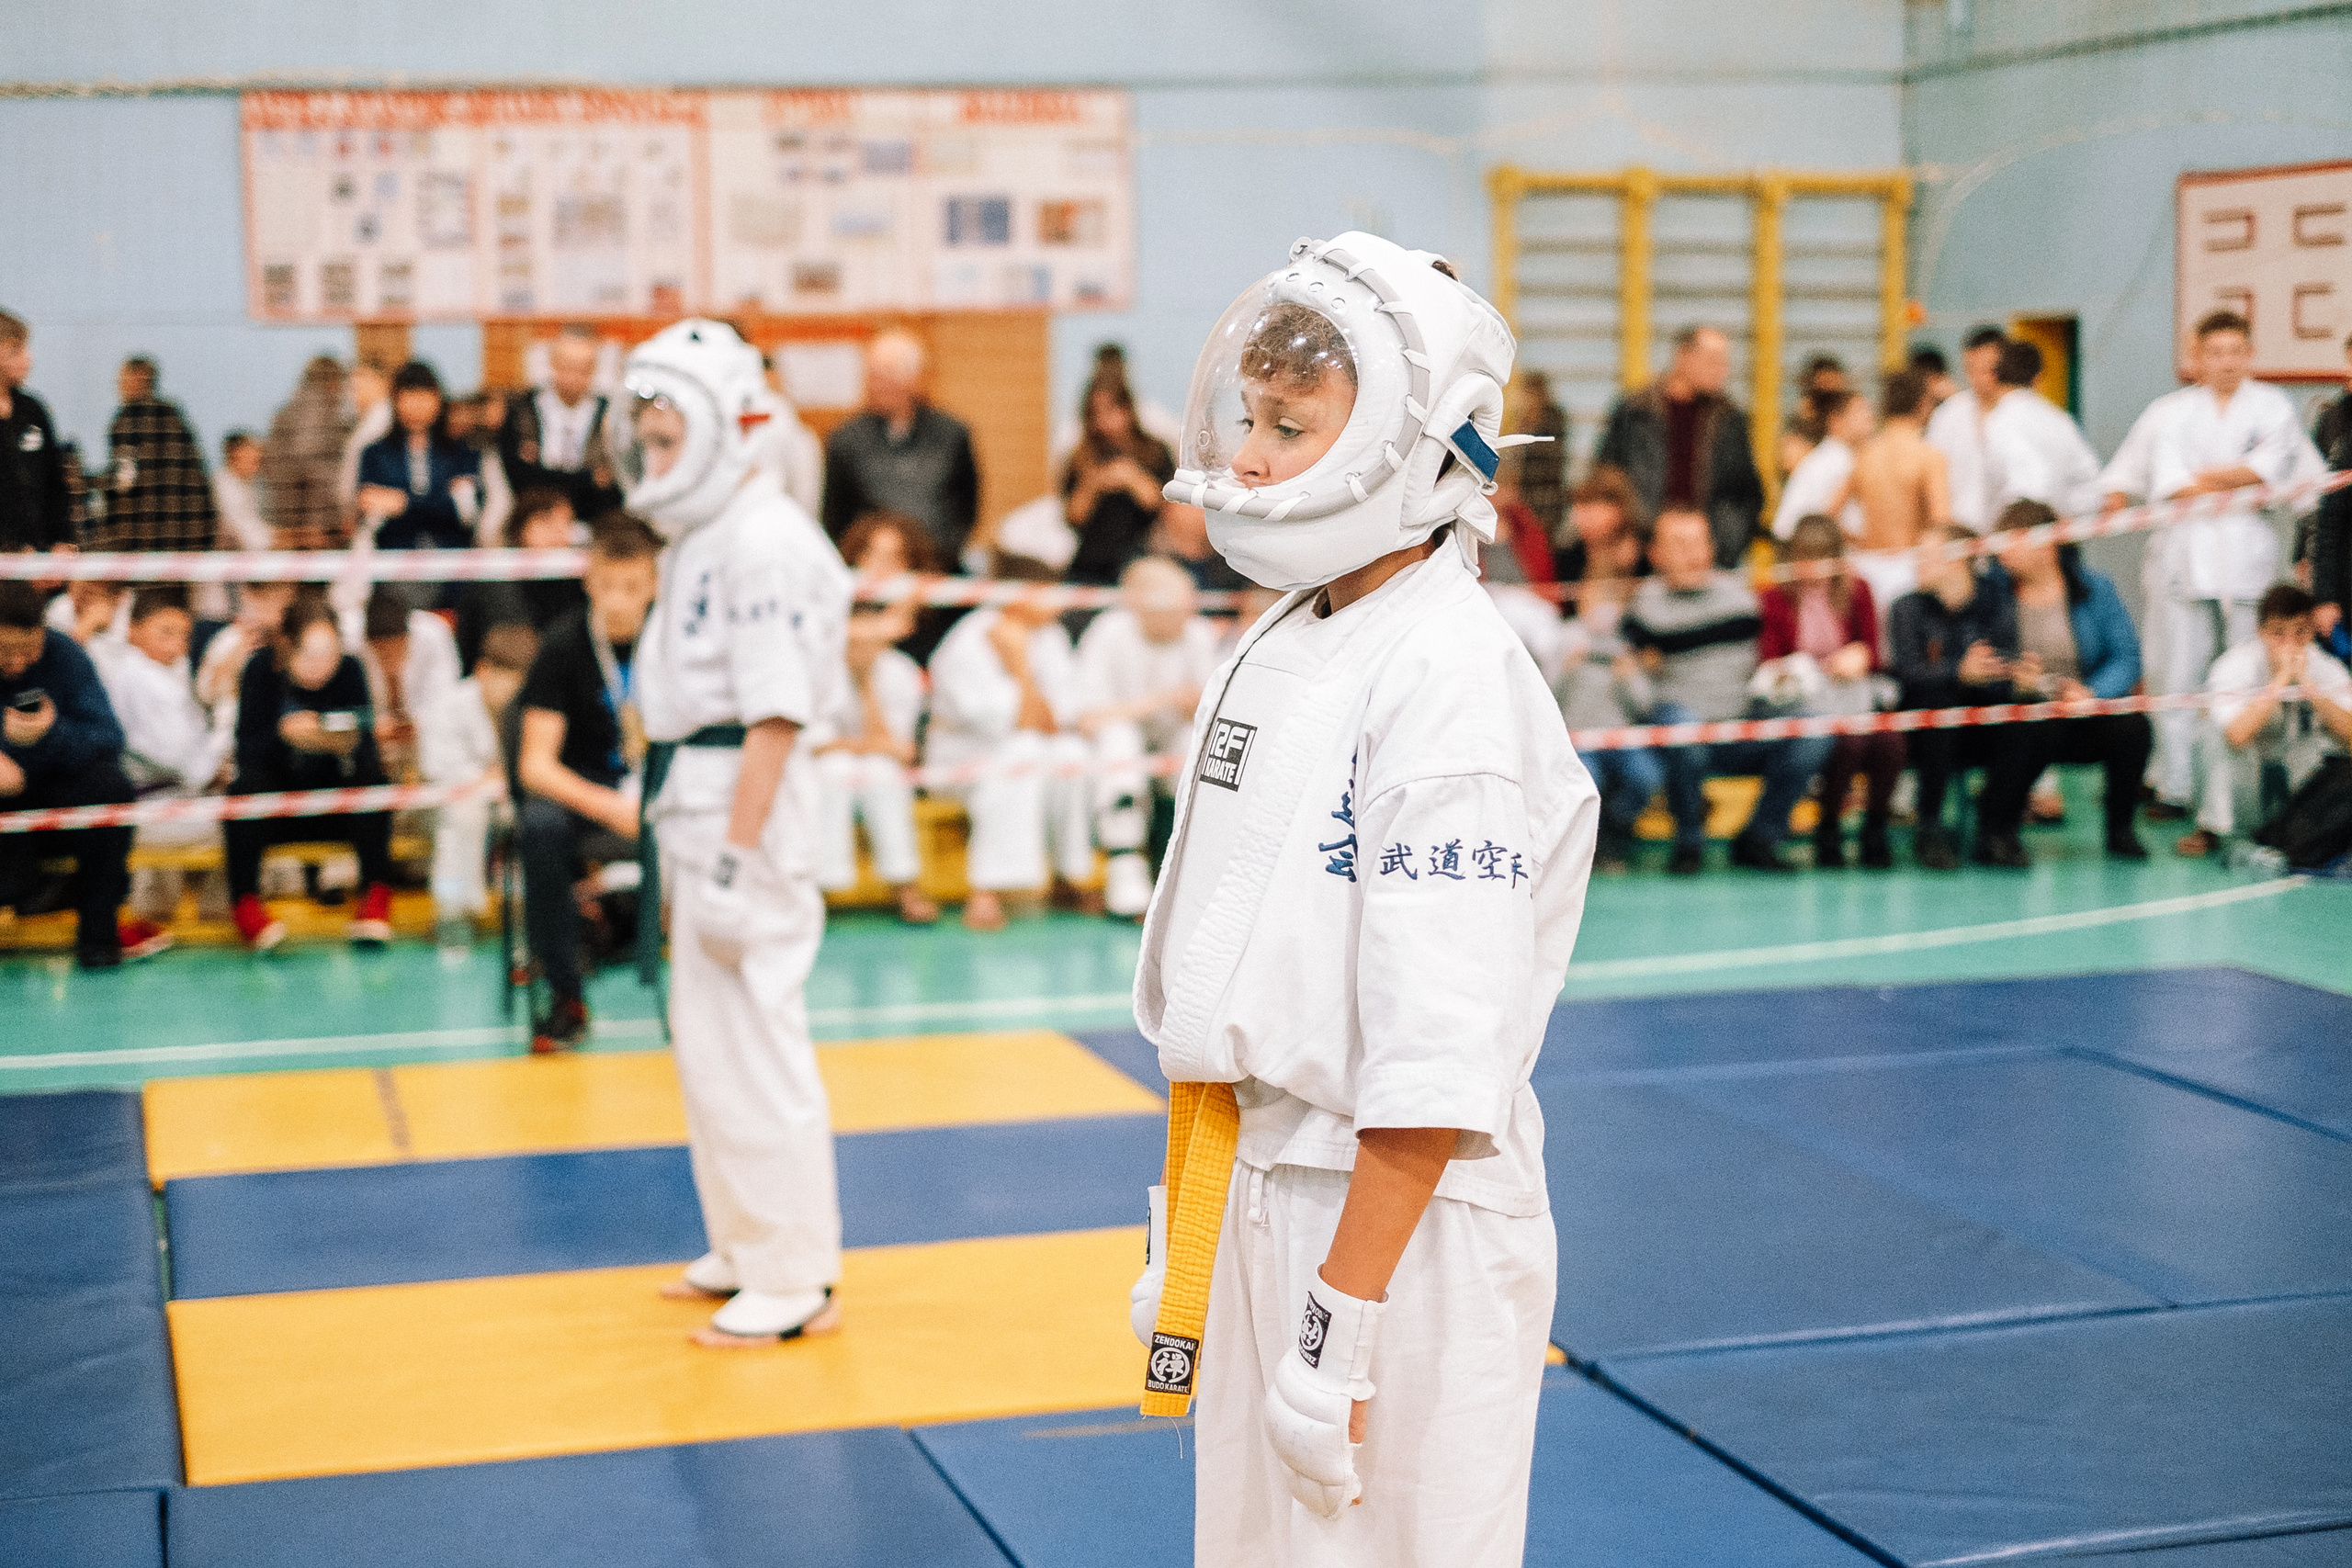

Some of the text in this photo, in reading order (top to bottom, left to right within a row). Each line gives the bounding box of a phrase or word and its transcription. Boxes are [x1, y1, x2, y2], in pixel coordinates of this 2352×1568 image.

[1204, 757, 1237, 783] KARATE
[1154, 1335, 1194, 1350] ZENDOKAI
[1148, 1379, 1189, 1393] BUDO KARATE
